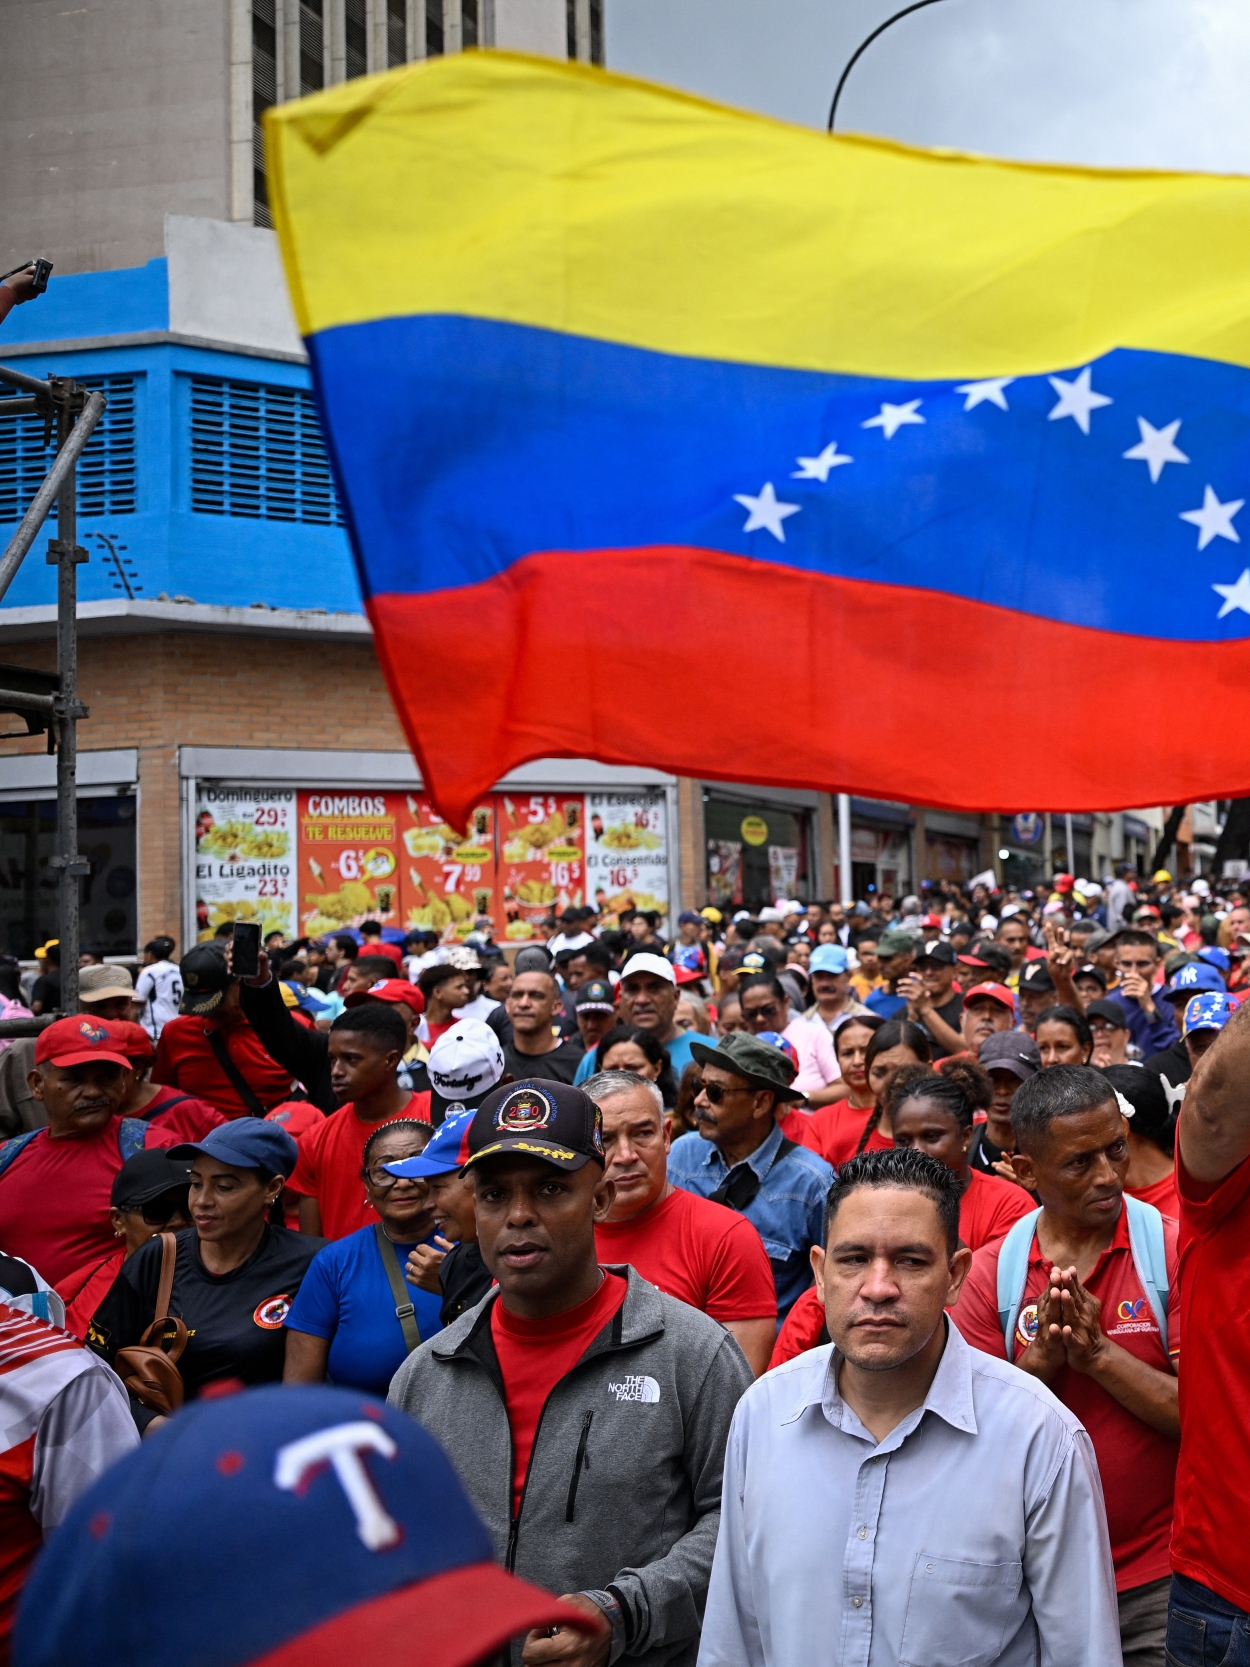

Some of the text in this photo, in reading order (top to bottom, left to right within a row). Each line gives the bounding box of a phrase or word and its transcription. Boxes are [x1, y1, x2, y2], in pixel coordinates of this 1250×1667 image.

[308, 796, 386, 817] COMBOS
[307, 825, 392, 840] TE RESUELVE
[197, 862, 290, 880] El Ligadito
[172, 980, 182, 1005] 5
[514, 1083, 535, 1091] NAVAL
[538, 1086, 558, 1122] LIBERTADORA
[608, 1383, 643, 1393] NORTH
[625, 1376, 645, 1384] THE
[616, 1393, 642, 1401] FACE
[275, 1421, 403, 1554] T
